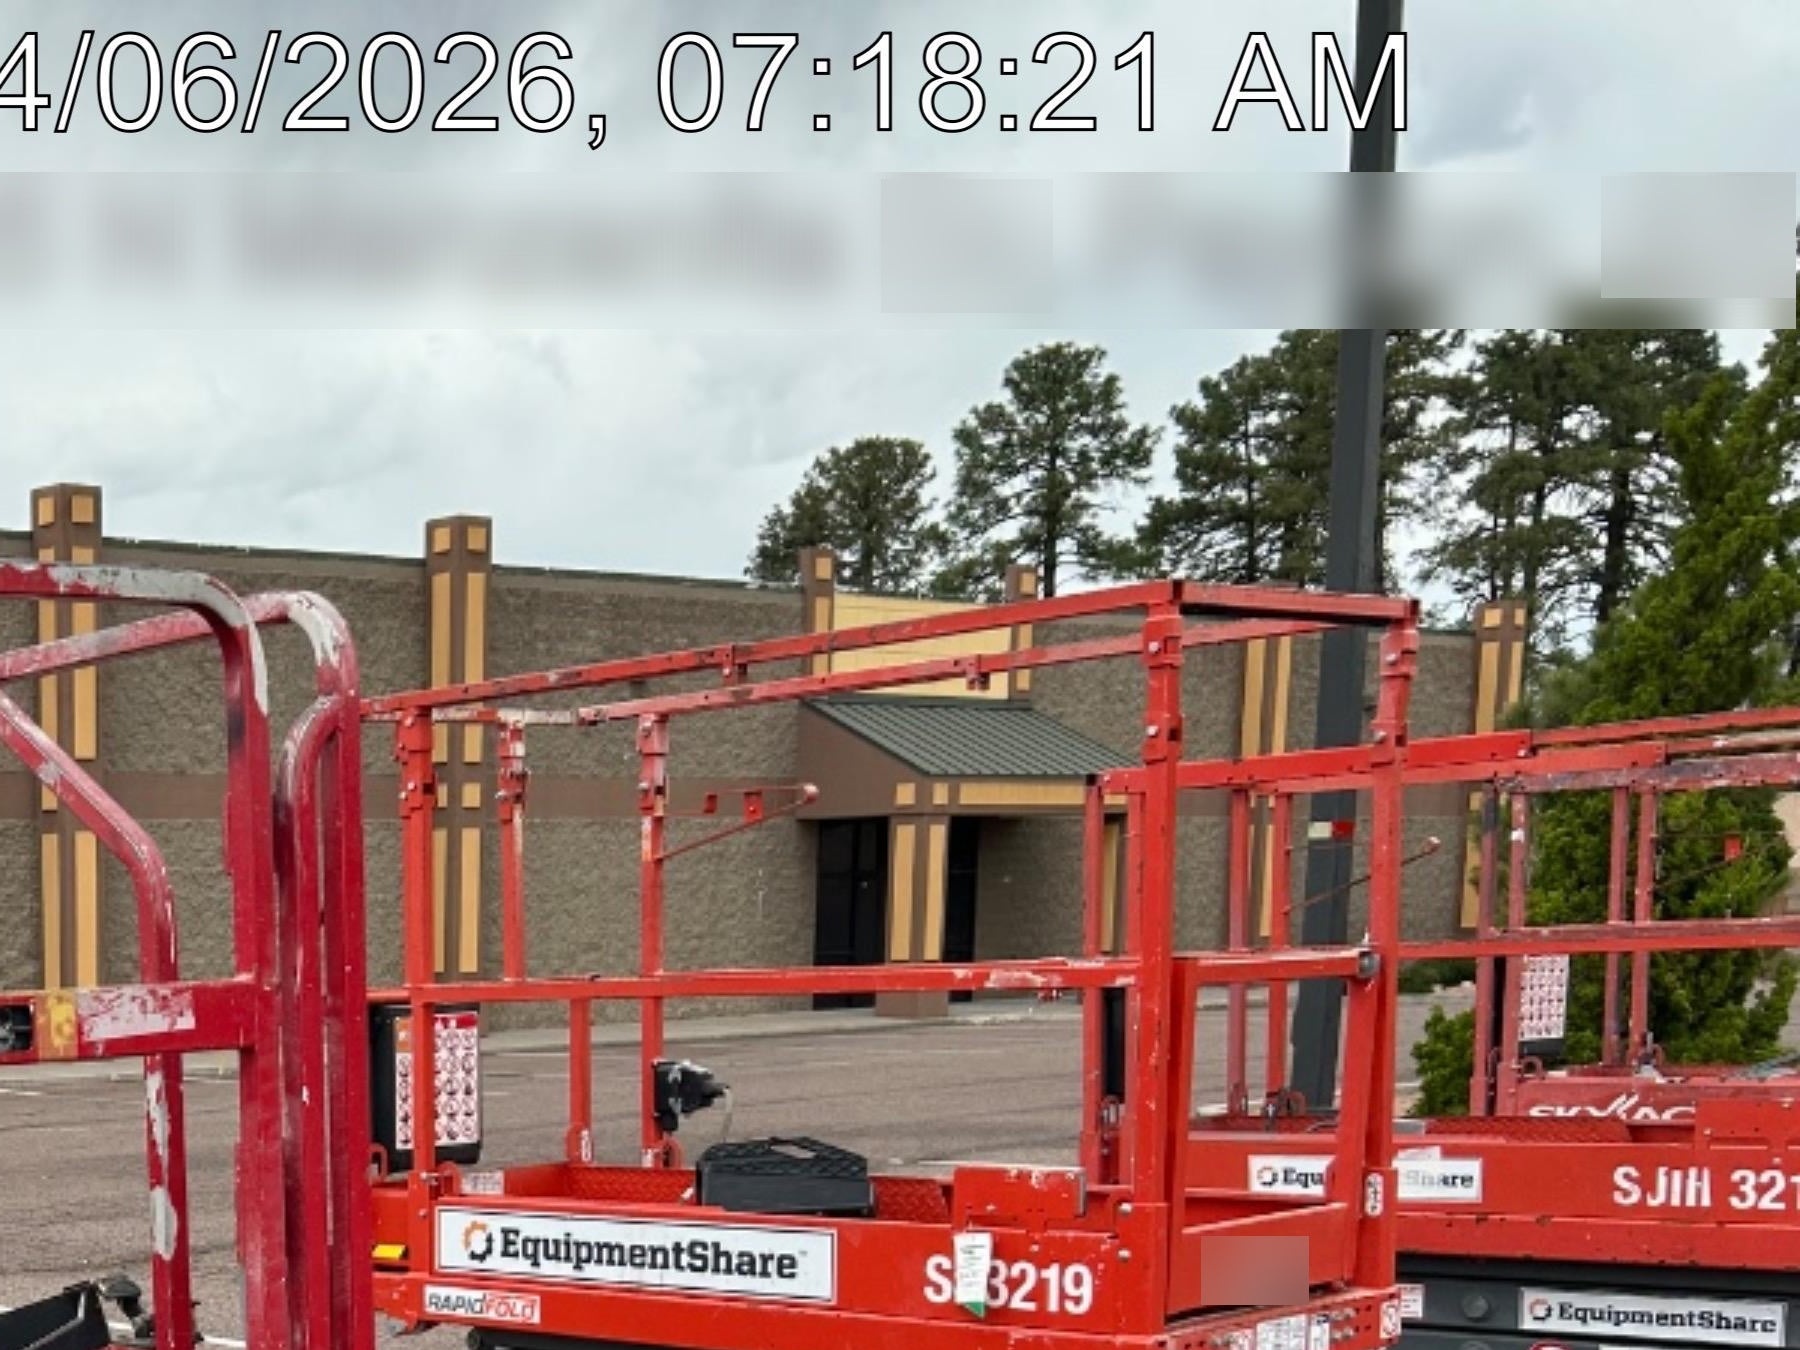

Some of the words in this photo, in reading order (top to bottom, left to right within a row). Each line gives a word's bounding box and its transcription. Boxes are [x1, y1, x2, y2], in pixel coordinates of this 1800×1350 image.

[499, 1226, 799, 1280] EquipmentShare
[922, 1254, 1094, 1316] S3219
[1557, 1301, 1778, 1334] EquipmentShare
